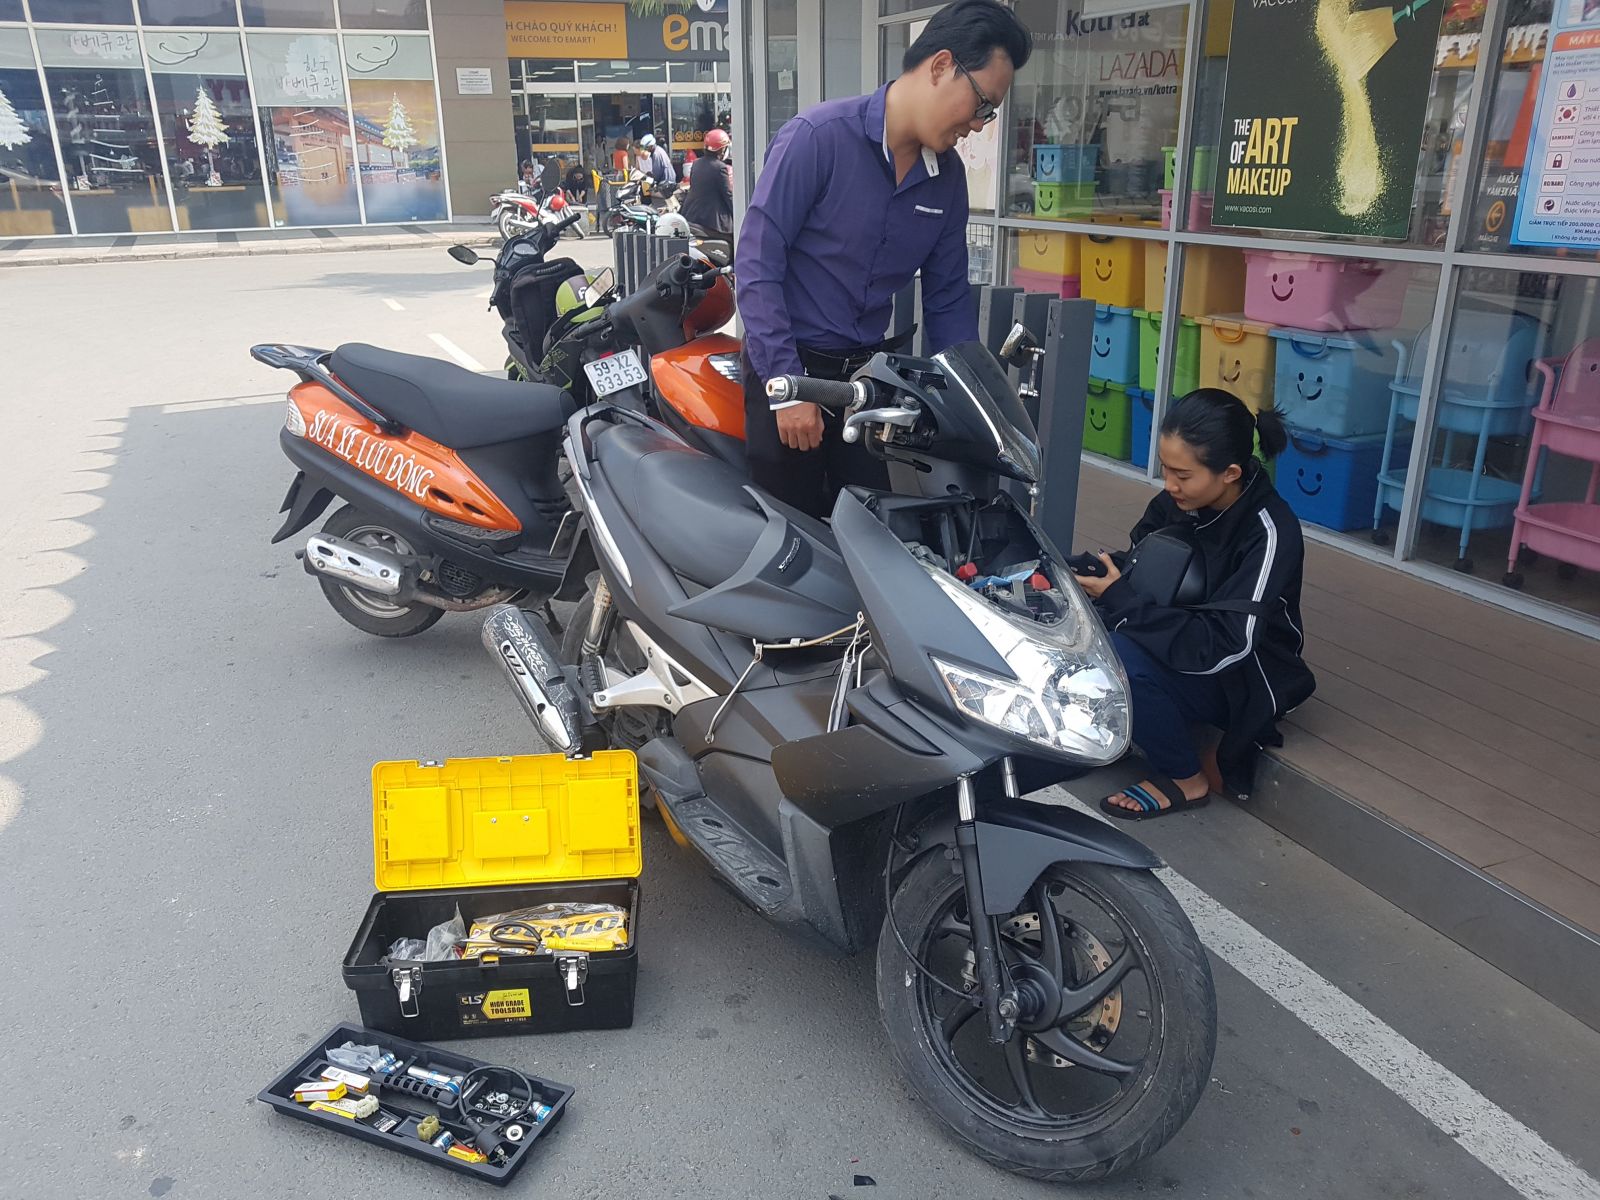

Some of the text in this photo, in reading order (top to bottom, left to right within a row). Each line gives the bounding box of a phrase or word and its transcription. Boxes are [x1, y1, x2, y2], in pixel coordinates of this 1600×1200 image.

[550, 20, 574, 33] QUÝ
[575, 20, 612, 32] KHÁCH
[663, 13, 730, 51] em
[511, 35, 552, 43] WELCOME
[552, 36, 564, 44] TO
[565, 36, 592, 44] EMART
[1099, 48, 1179, 81] LAZADA
[1229, 140, 1247, 164] OF
[1234, 116, 1299, 165] THE ART
[1226, 167, 1292, 196] MAKEUP
[1225, 205, 1272, 214] www.vacosi.com
[593, 354, 633, 377] 59-X2
[596, 366, 643, 393] 633.53
[335, 424, 363, 461] XE
[384, 453, 435, 499] ĐỘNG
[490, 1006, 526, 1015] TOOLSBOX
